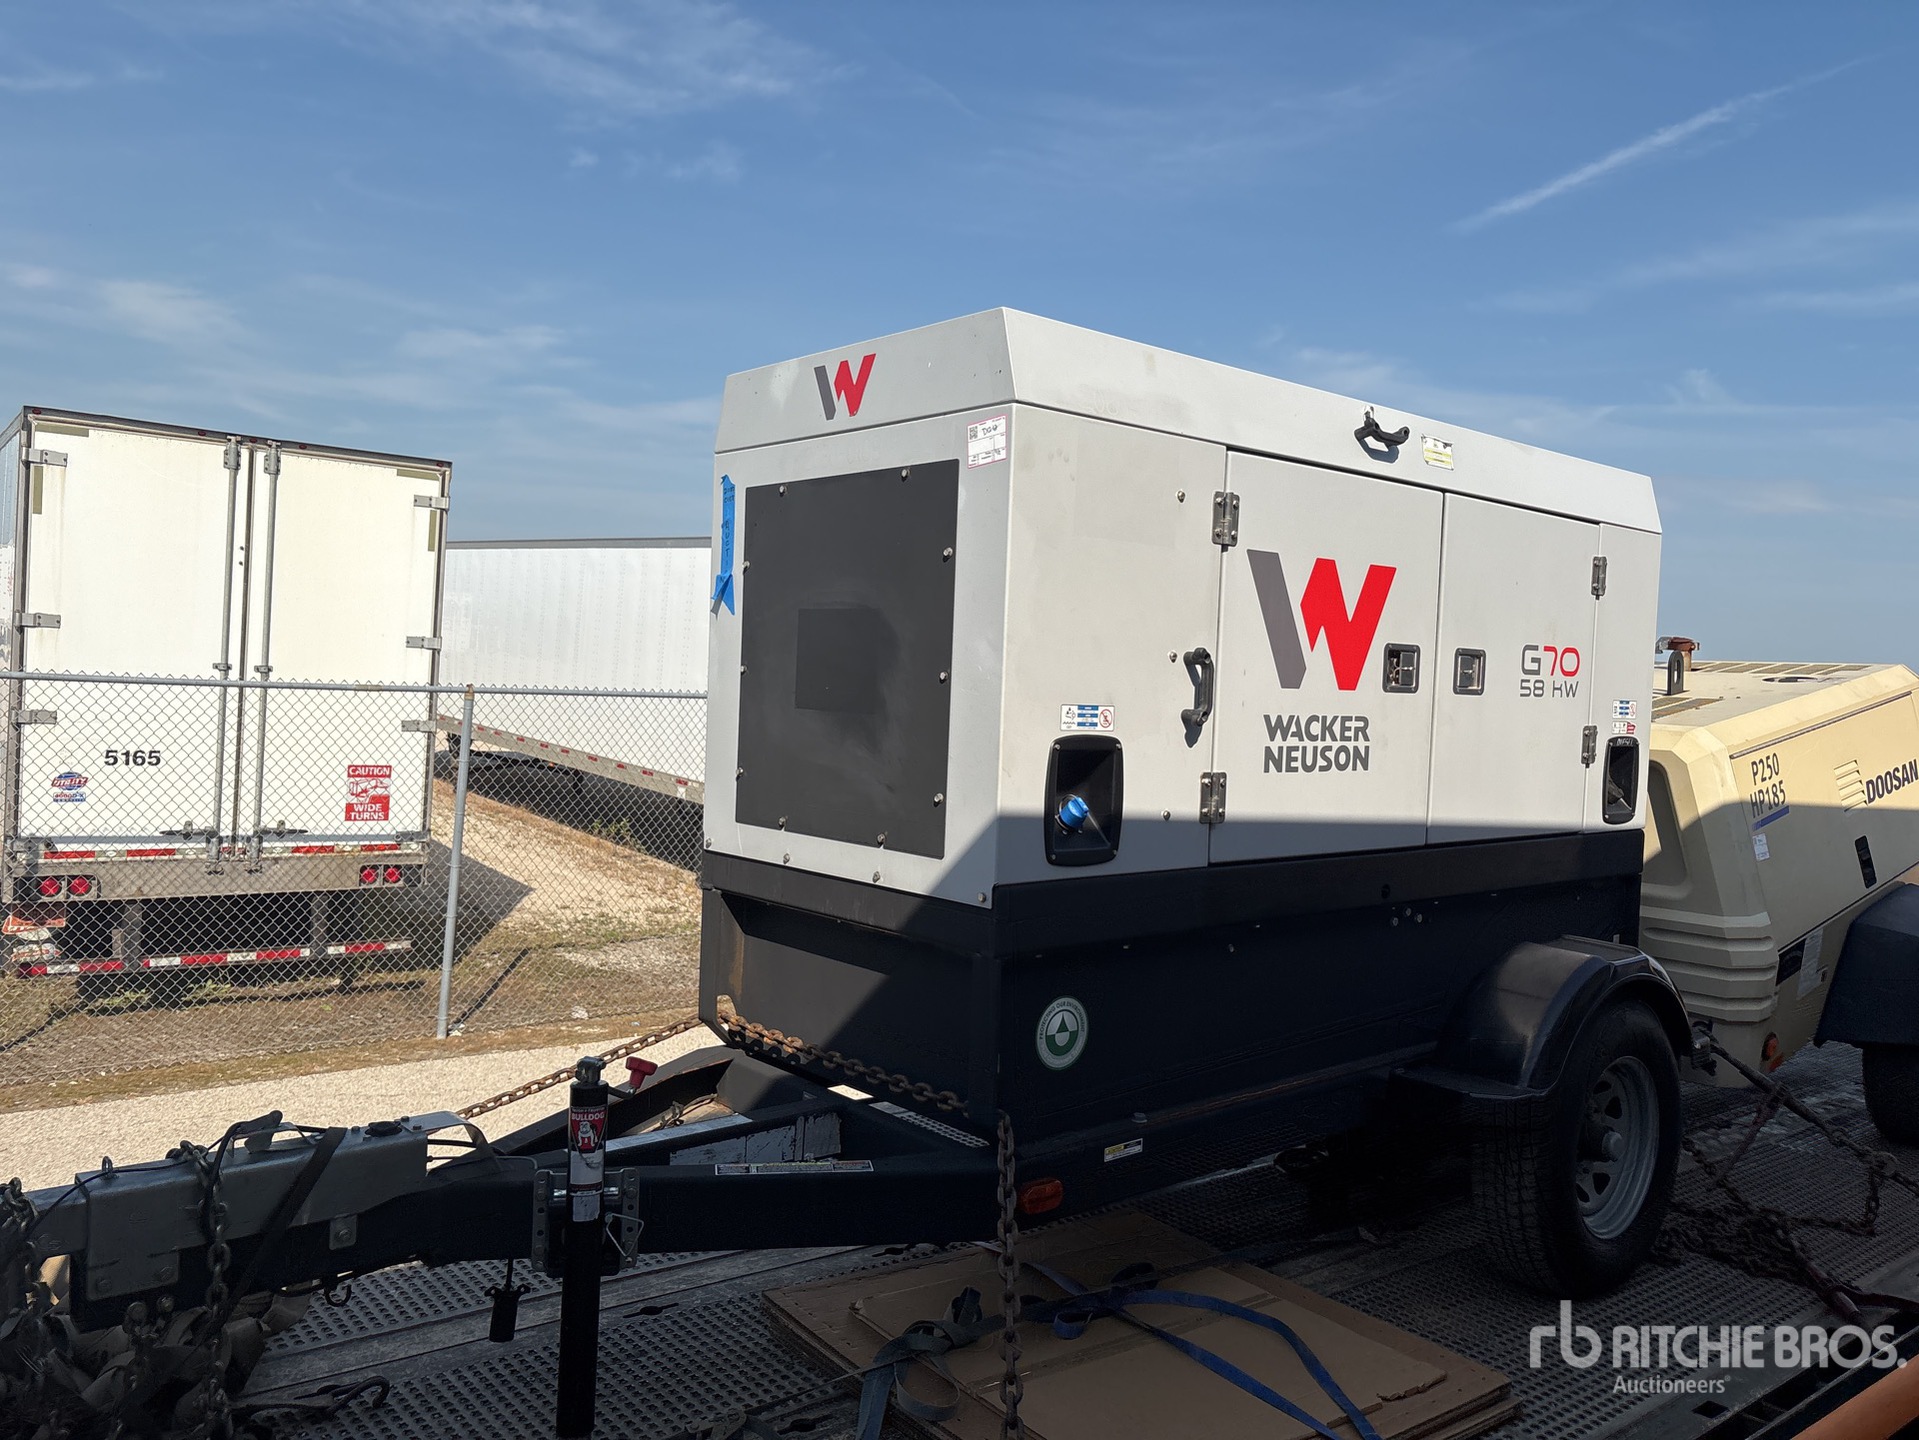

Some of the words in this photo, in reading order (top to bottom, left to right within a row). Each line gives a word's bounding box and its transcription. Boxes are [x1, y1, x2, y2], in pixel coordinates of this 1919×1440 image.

[1520, 644, 1581, 677] G70
[1519, 680, 1544, 698] 58
[1263, 714, 1371, 743] WACKER
[103, 749, 162, 767] 5165
[1263, 745, 1371, 774] NEUSON
[1750, 753, 1780, 786] P250
[349, 766, 391, 776] CAUTION
[1865, 758, 1919, 804] DOOSAN
[353, 803, 383, 812] WIDE
[1750, 780, 1786, 818] HP185
[350, 812, 385, 820] TURNS
[571, 1112, 605, 1121] BULLDOG
